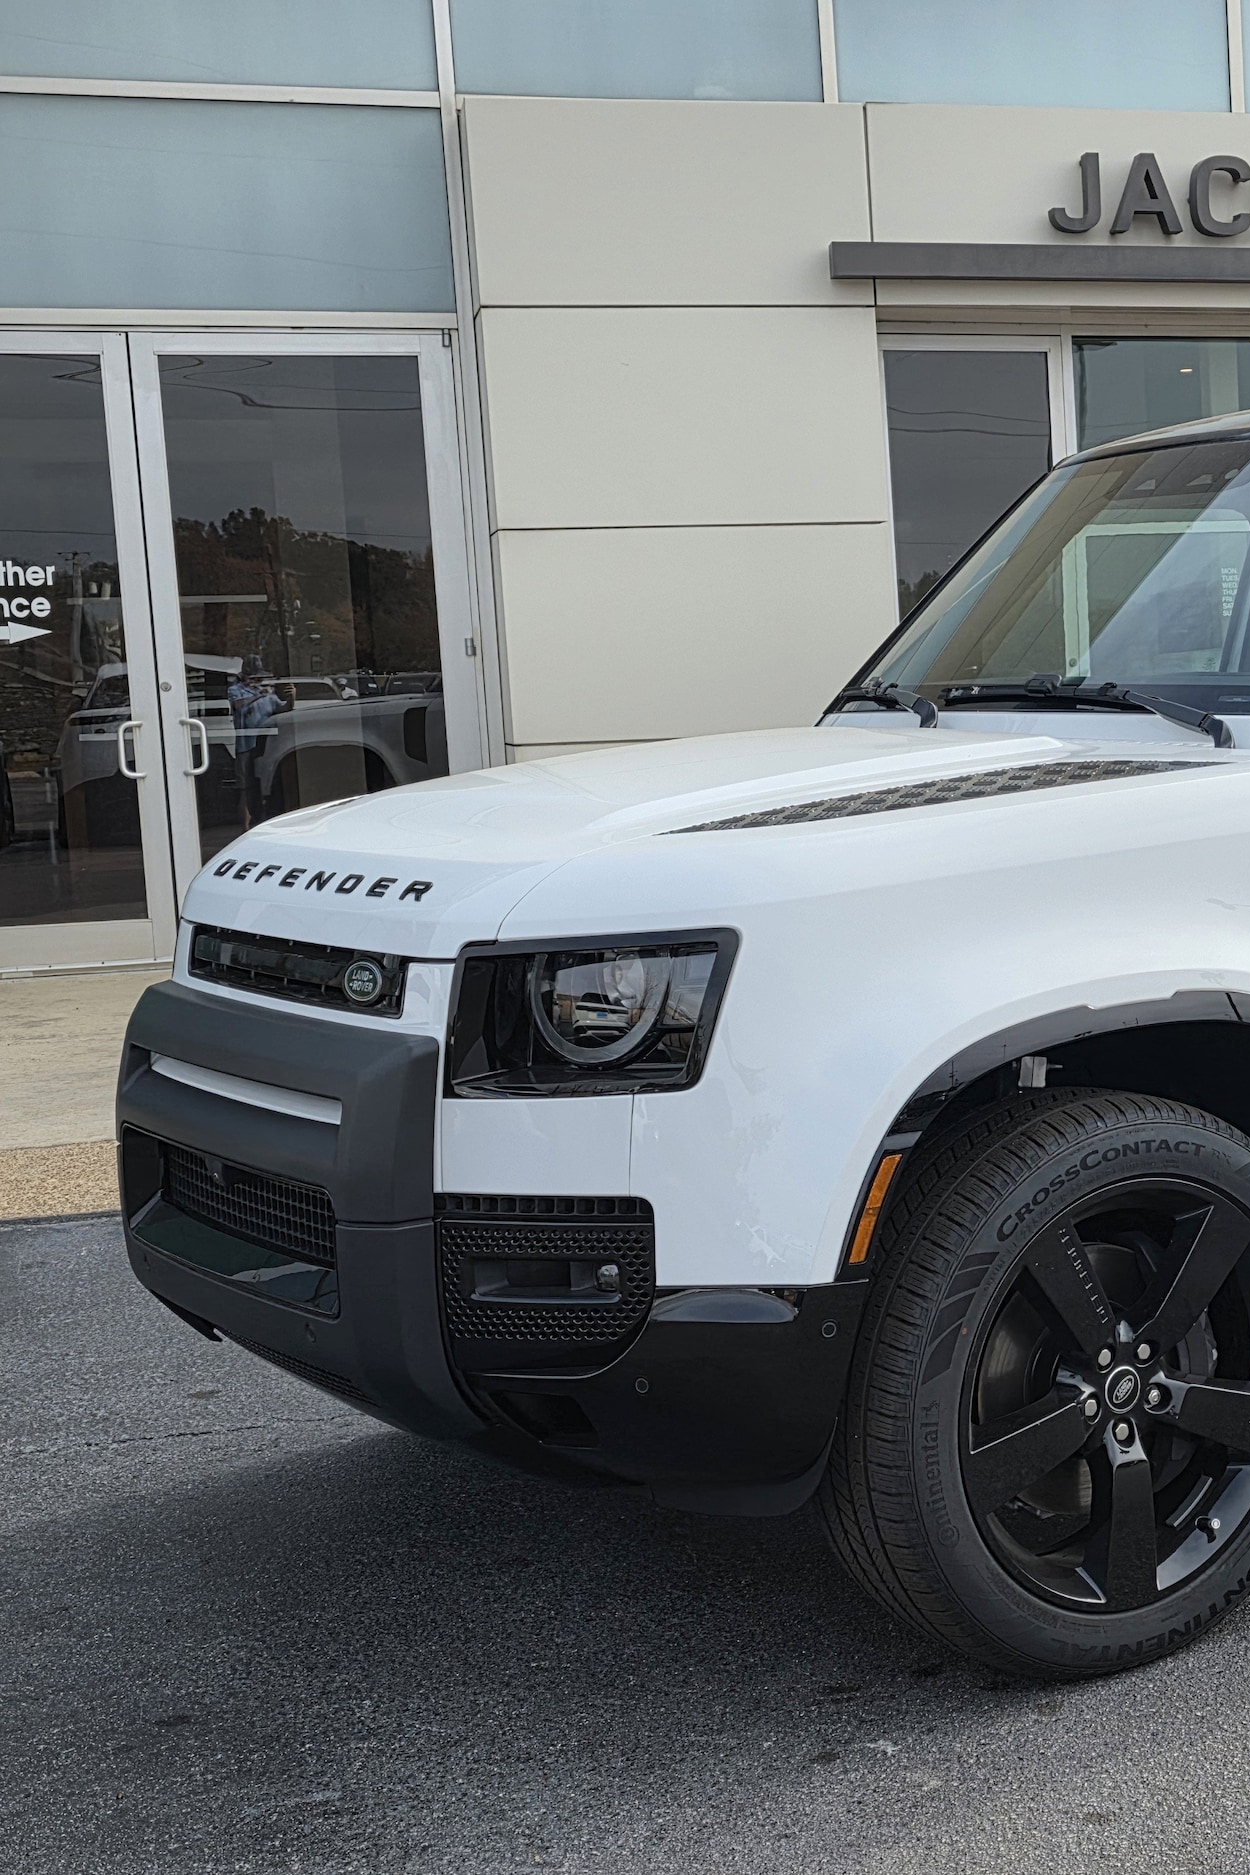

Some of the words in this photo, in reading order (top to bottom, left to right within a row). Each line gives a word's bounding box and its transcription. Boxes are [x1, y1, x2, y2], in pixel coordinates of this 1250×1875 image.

[213, 859, 433, 902] DEFENDER
[352, 969, 370, 981] LAND
[351, 980, 374, 993] ROVER
